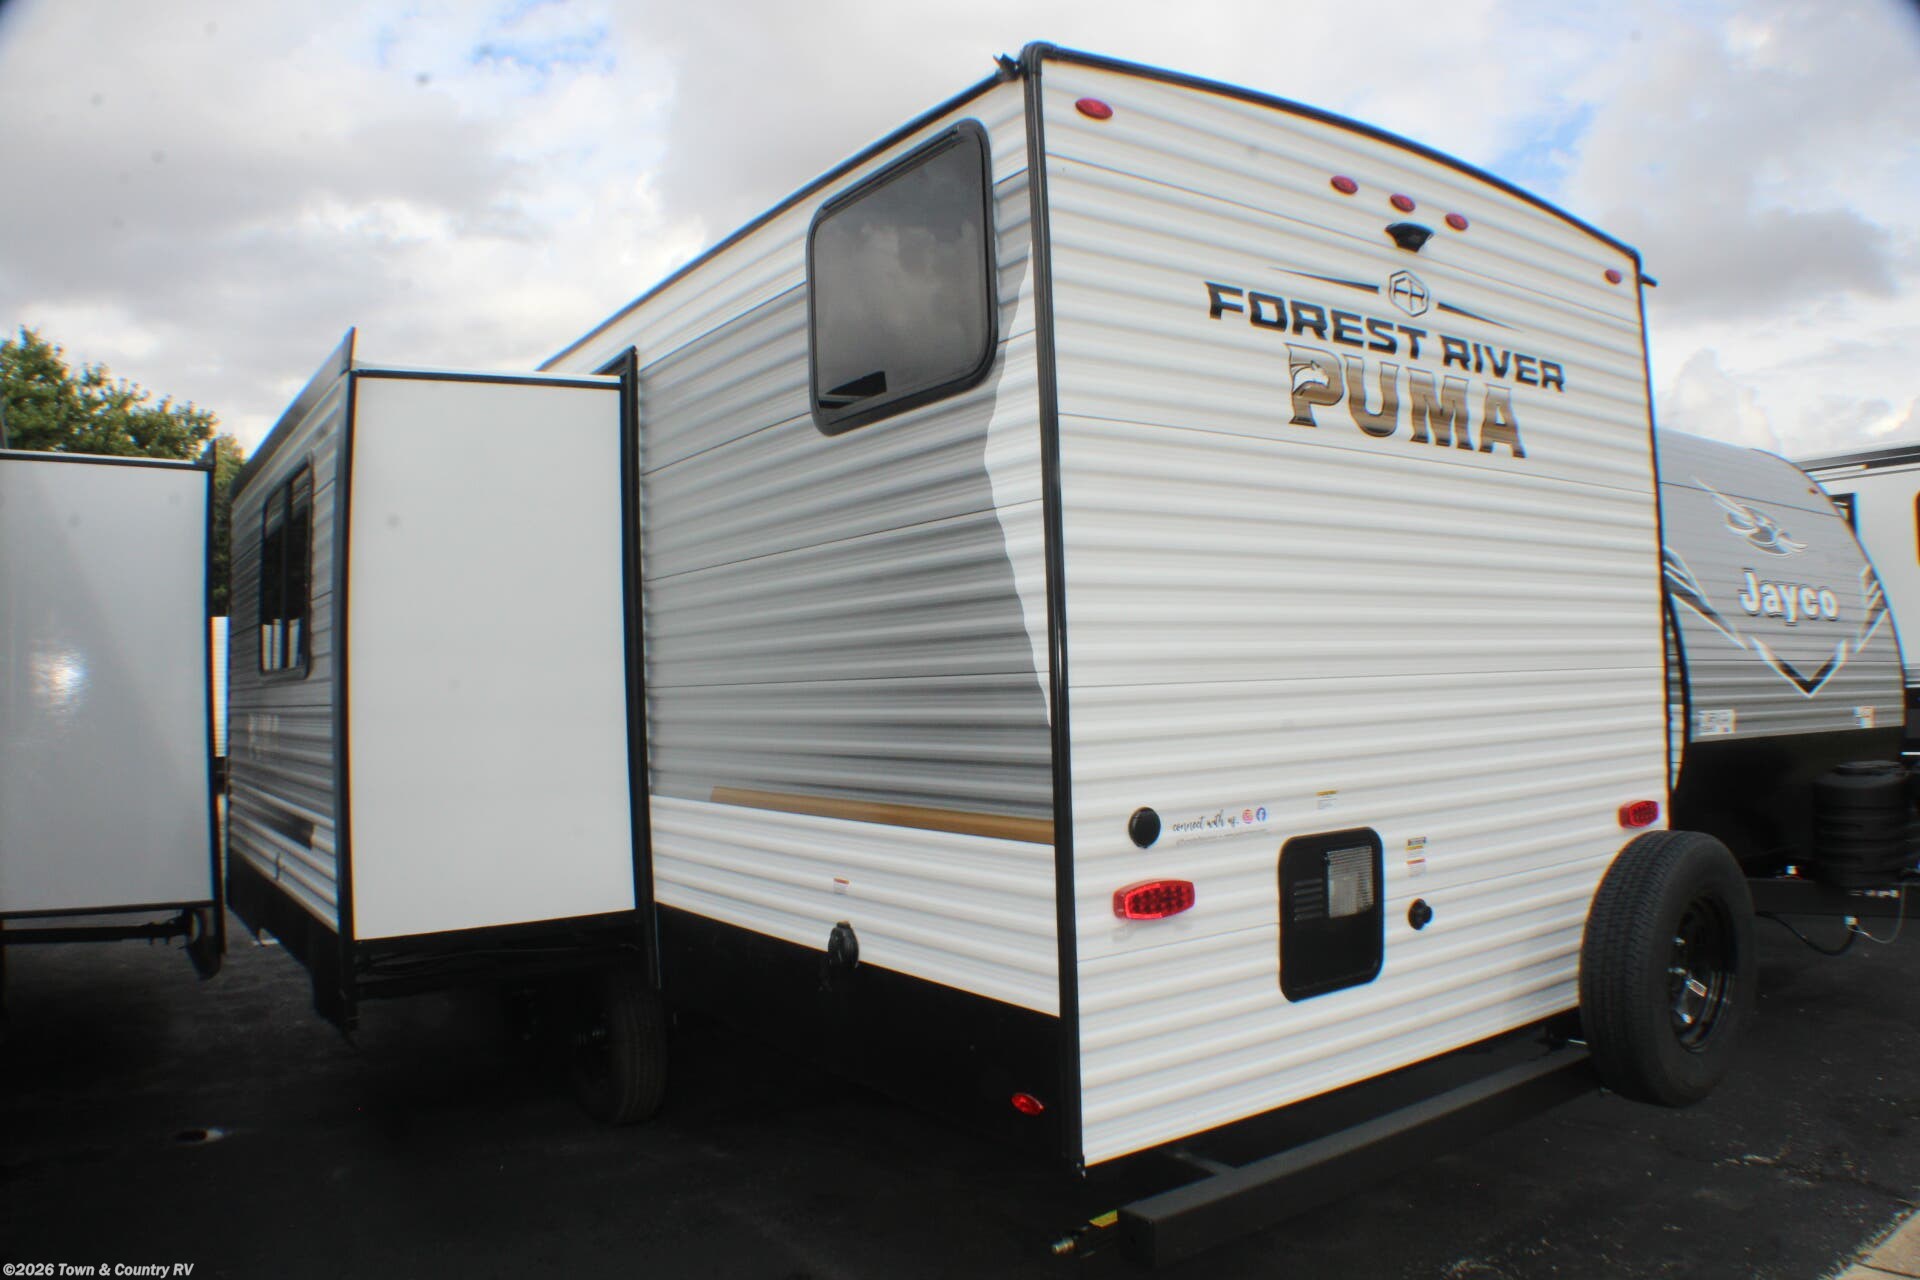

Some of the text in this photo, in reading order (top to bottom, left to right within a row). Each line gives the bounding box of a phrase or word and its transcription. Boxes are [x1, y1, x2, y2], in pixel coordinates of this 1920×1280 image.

[1204, 280, 1427, 360] FOREST
[1439, 334, 1566, 393] RIVER
[1284, 342, 1527, 459] PUMA
[1738, 567, 1840, 627] Jayco
[1172, 815, 1205, 833] connect
